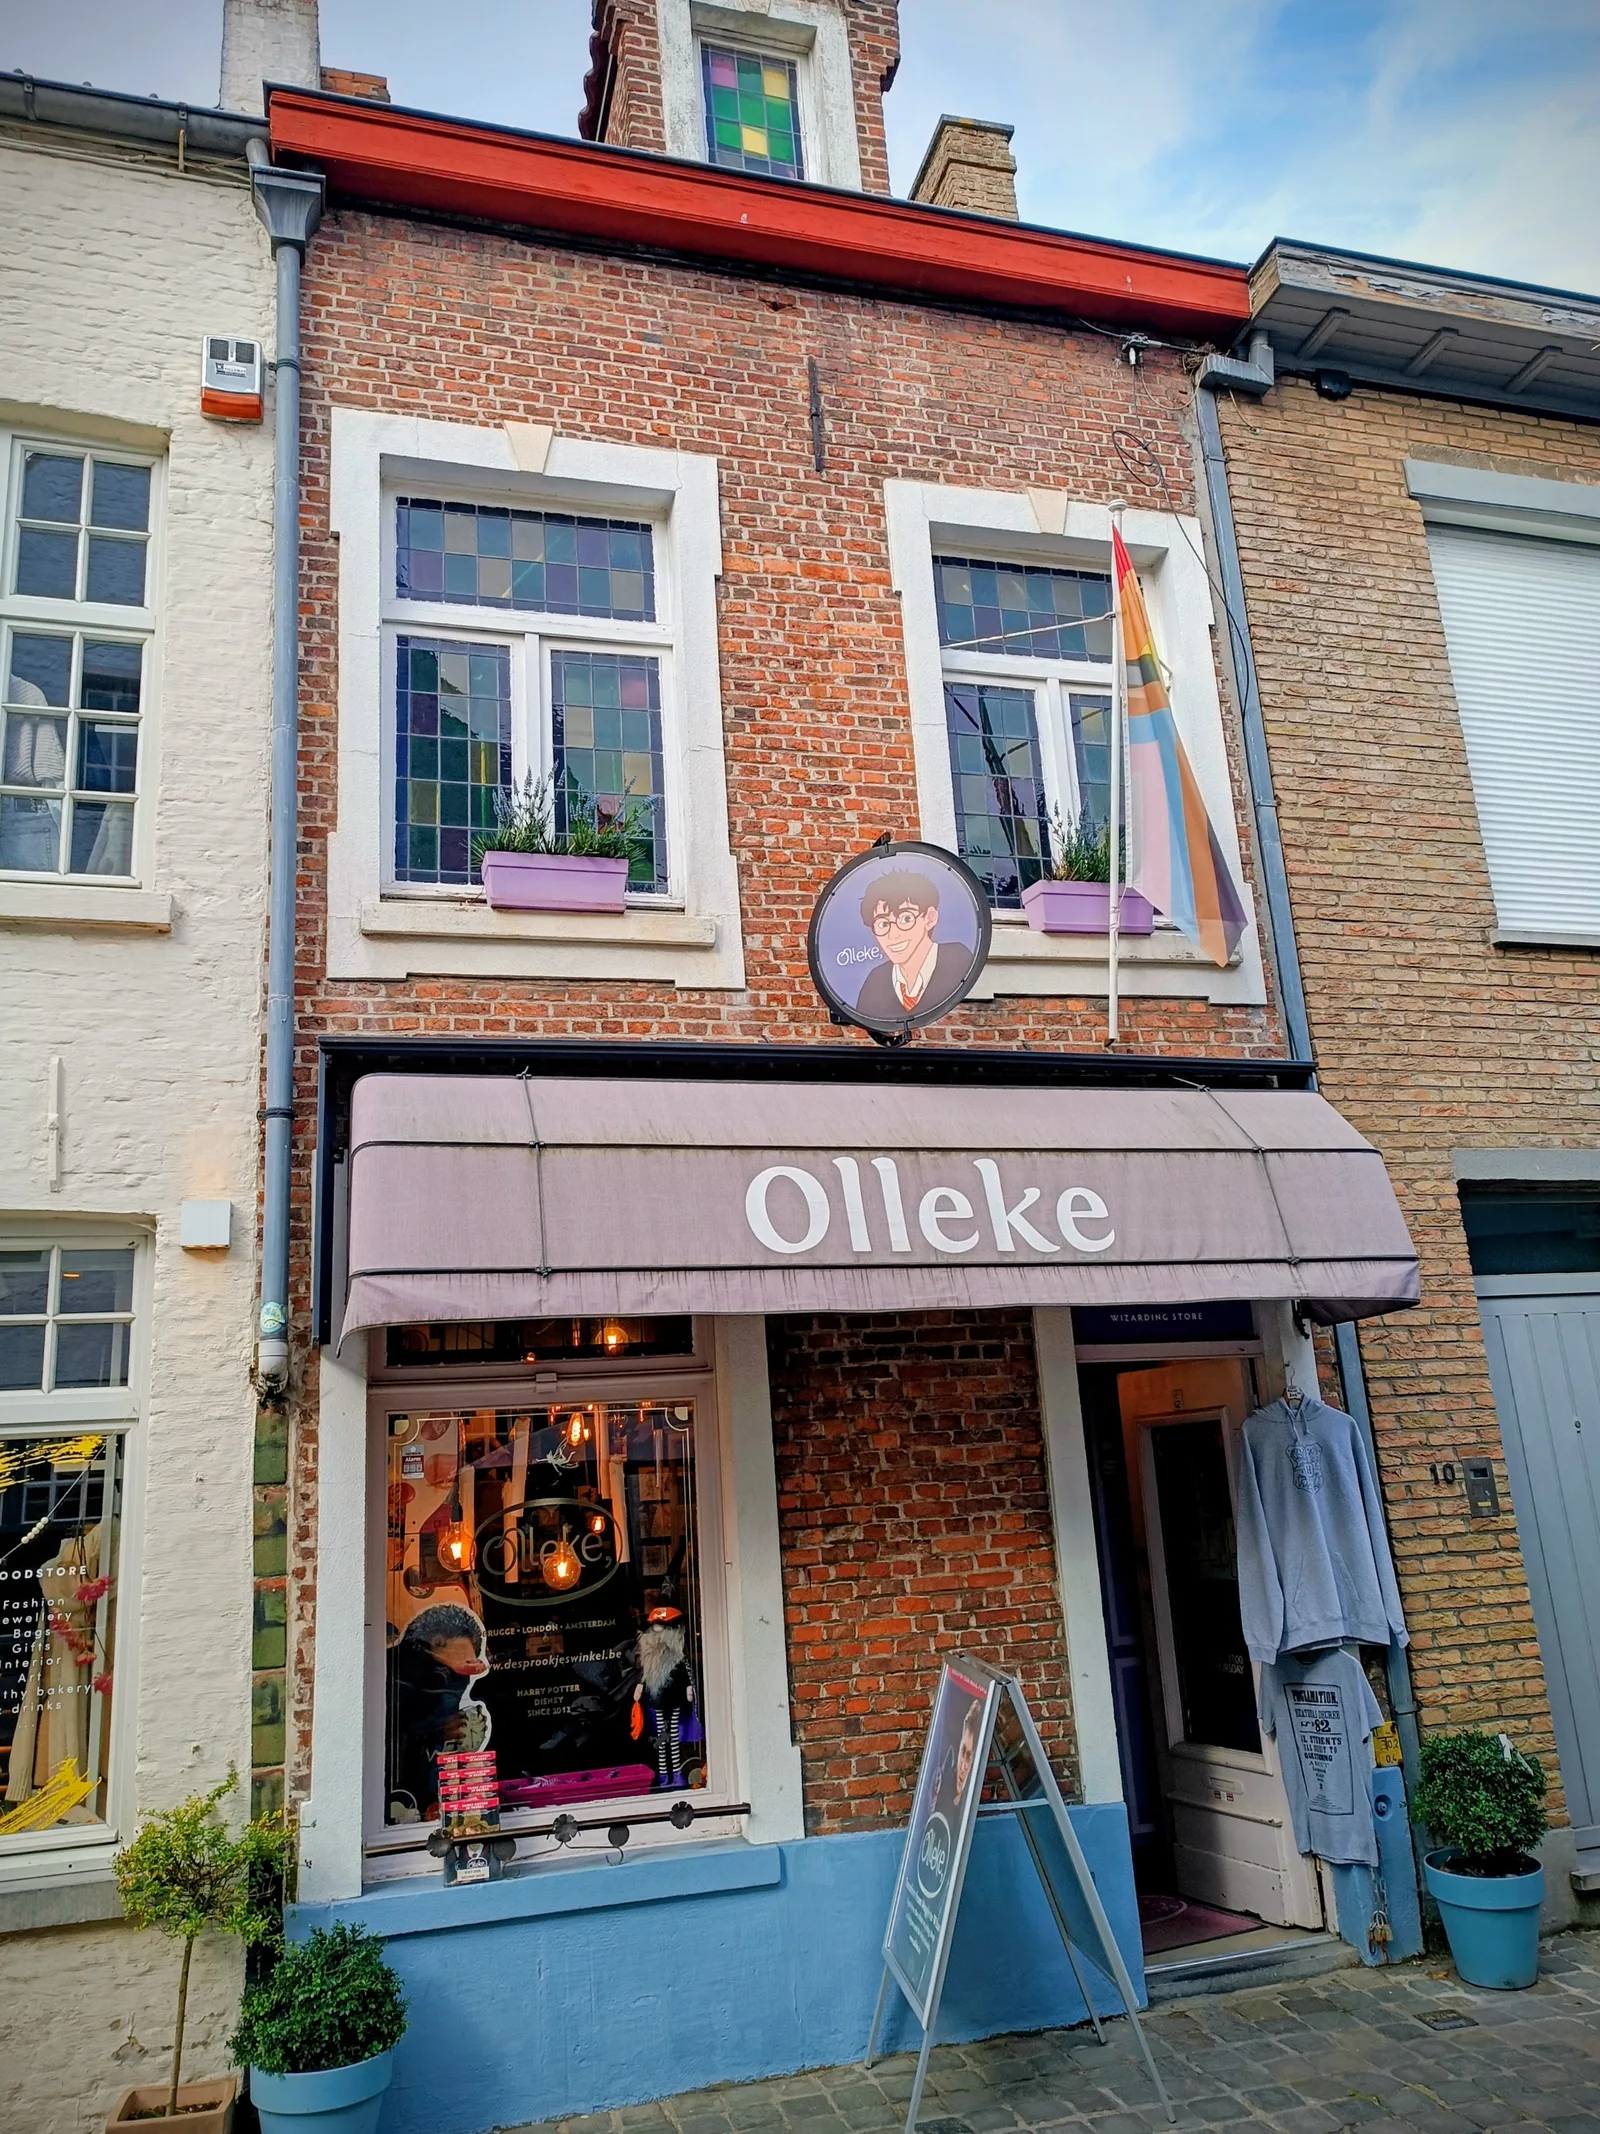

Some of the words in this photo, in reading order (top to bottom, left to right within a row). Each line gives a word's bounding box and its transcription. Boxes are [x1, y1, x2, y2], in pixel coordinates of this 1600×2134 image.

[745, 1156, 1116, 1254] Olleke
[1110, 1313, 1168, 1322] WIZARDING
[1172, 1312, 1203, 1321] STORE
[1429, 1463, 1455, 1485] 10
[0, 1565, 87, 1580] OODSTORE
[3, 1597, 65, 1610] Fashion
[2, 1611, 72, 1625] ewellery
[13, 1628, 51, 1639] Bags
[482, 1627, 515, 1637] BRUGGE
[522, 1623, 558, 1634] LONDON
[565, 1618, 616, 1630] AMSTERDAM
[12, 1642, 51, 1654] Gifts
[17, 1672, 42, 1683] Art
[3, 1689, 28, 1701] thy
[36, 1684, 91, 1696] bakery
[517, 1687, 546, 1697] HARRY
[547, 1684, 580, 1694] POTTER
[11, 1701, 62, 1714] drinks
[534, 1696, 564, 1706] DISNEY
[527, 1709, 551, 1717] SINCE
[552, 1706, 572, 1715] 2012
